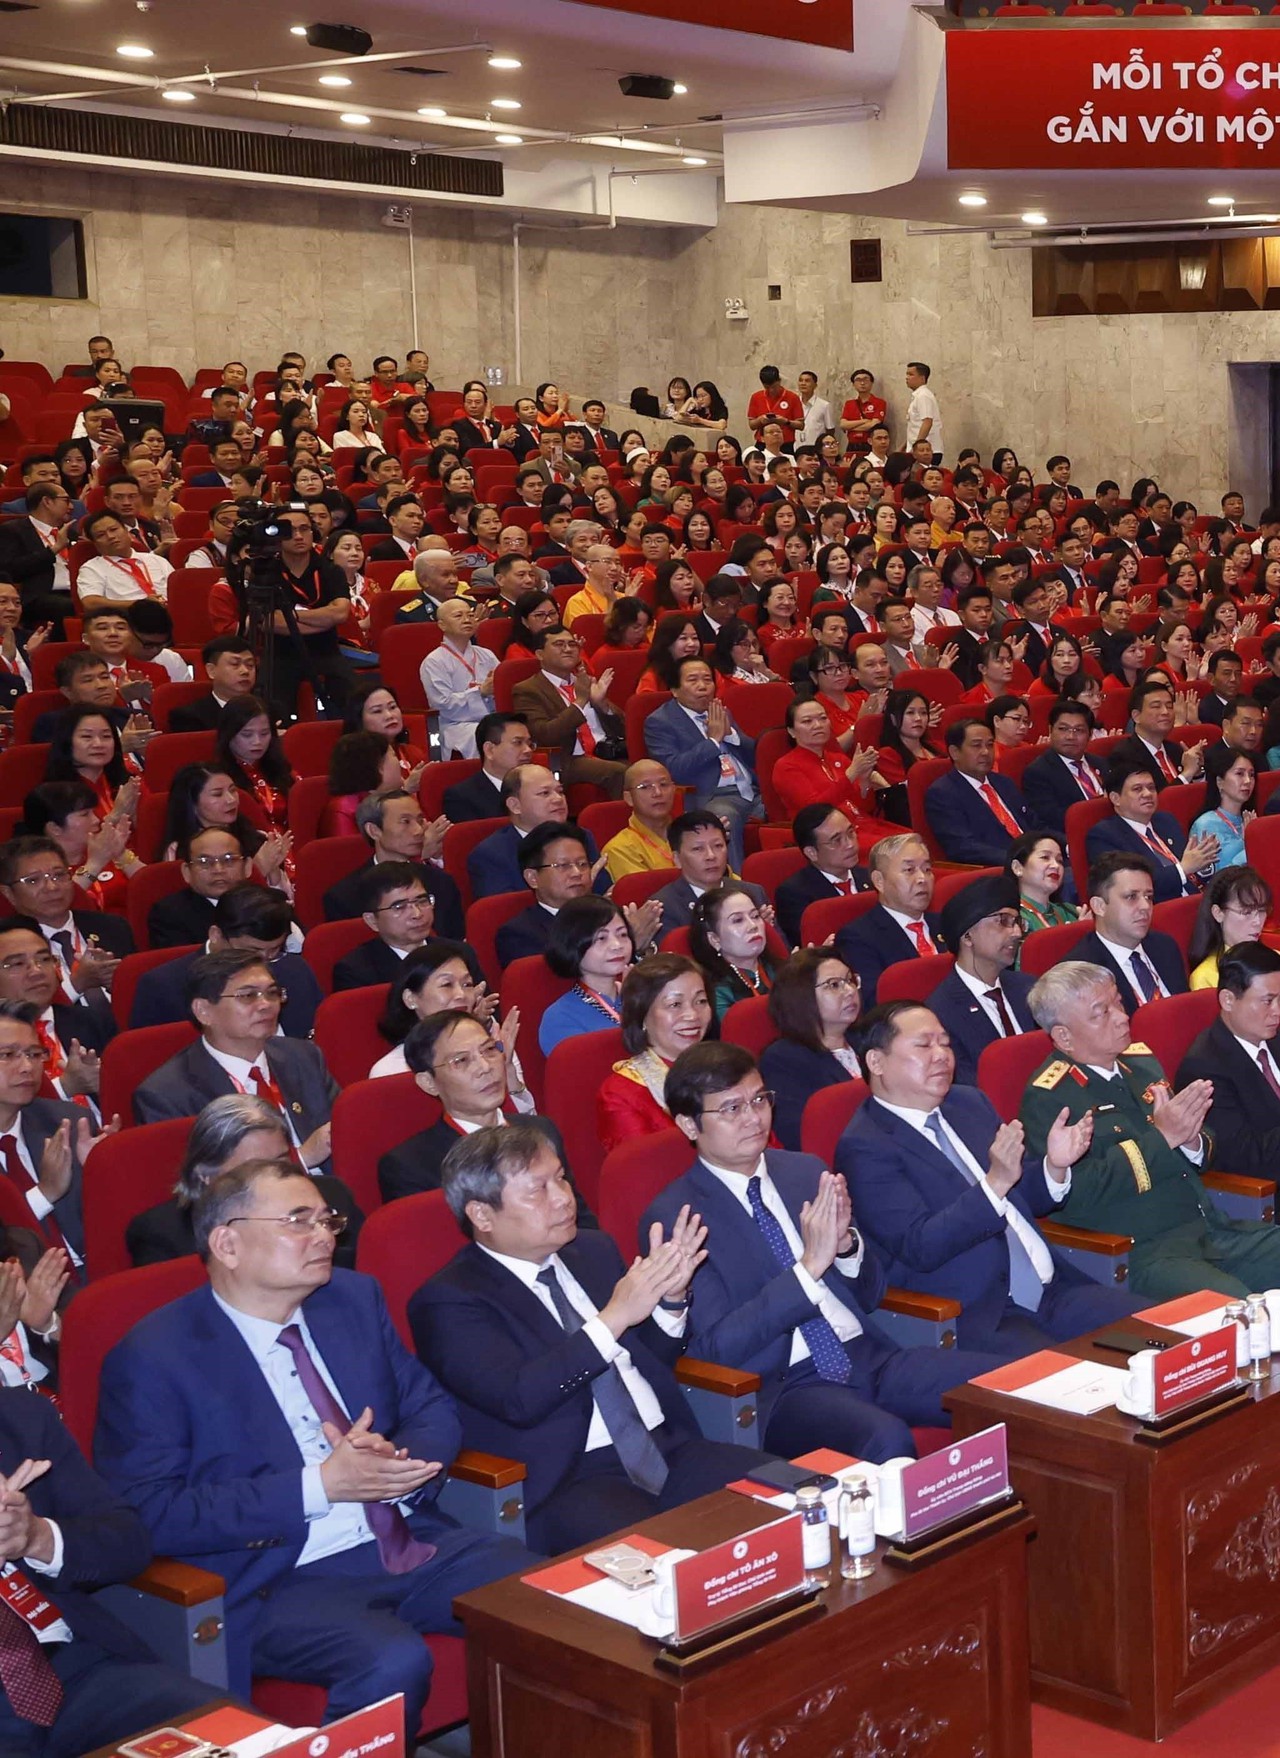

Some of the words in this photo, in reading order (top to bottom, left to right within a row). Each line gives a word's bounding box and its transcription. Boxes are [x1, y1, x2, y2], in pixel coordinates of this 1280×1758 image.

[1093, 48, 1161, 89] MỖI
[1173, 47, 1224, 89] TỔ
[1046, 100, 1126, 143] GẮN
[1138, 107, 1203, 142] VỚI
[430, 733, 441, 747] K
[917, 1485, 936, 1497] Đồng
[936, 1478, 946, 1489] chí
[970, 1457, 993, 1472] THẮNG
[704, 1576, 726, 1590] Đồng
[726, 1569, 739, 1580] chí
[739, 1562, 751, 1574] TÔ
[752, 1558, 764, 1569] ÂN
[766, 1551, 778, 1564] XÔ
[359, 1733, 395, 1754] THẮNG
